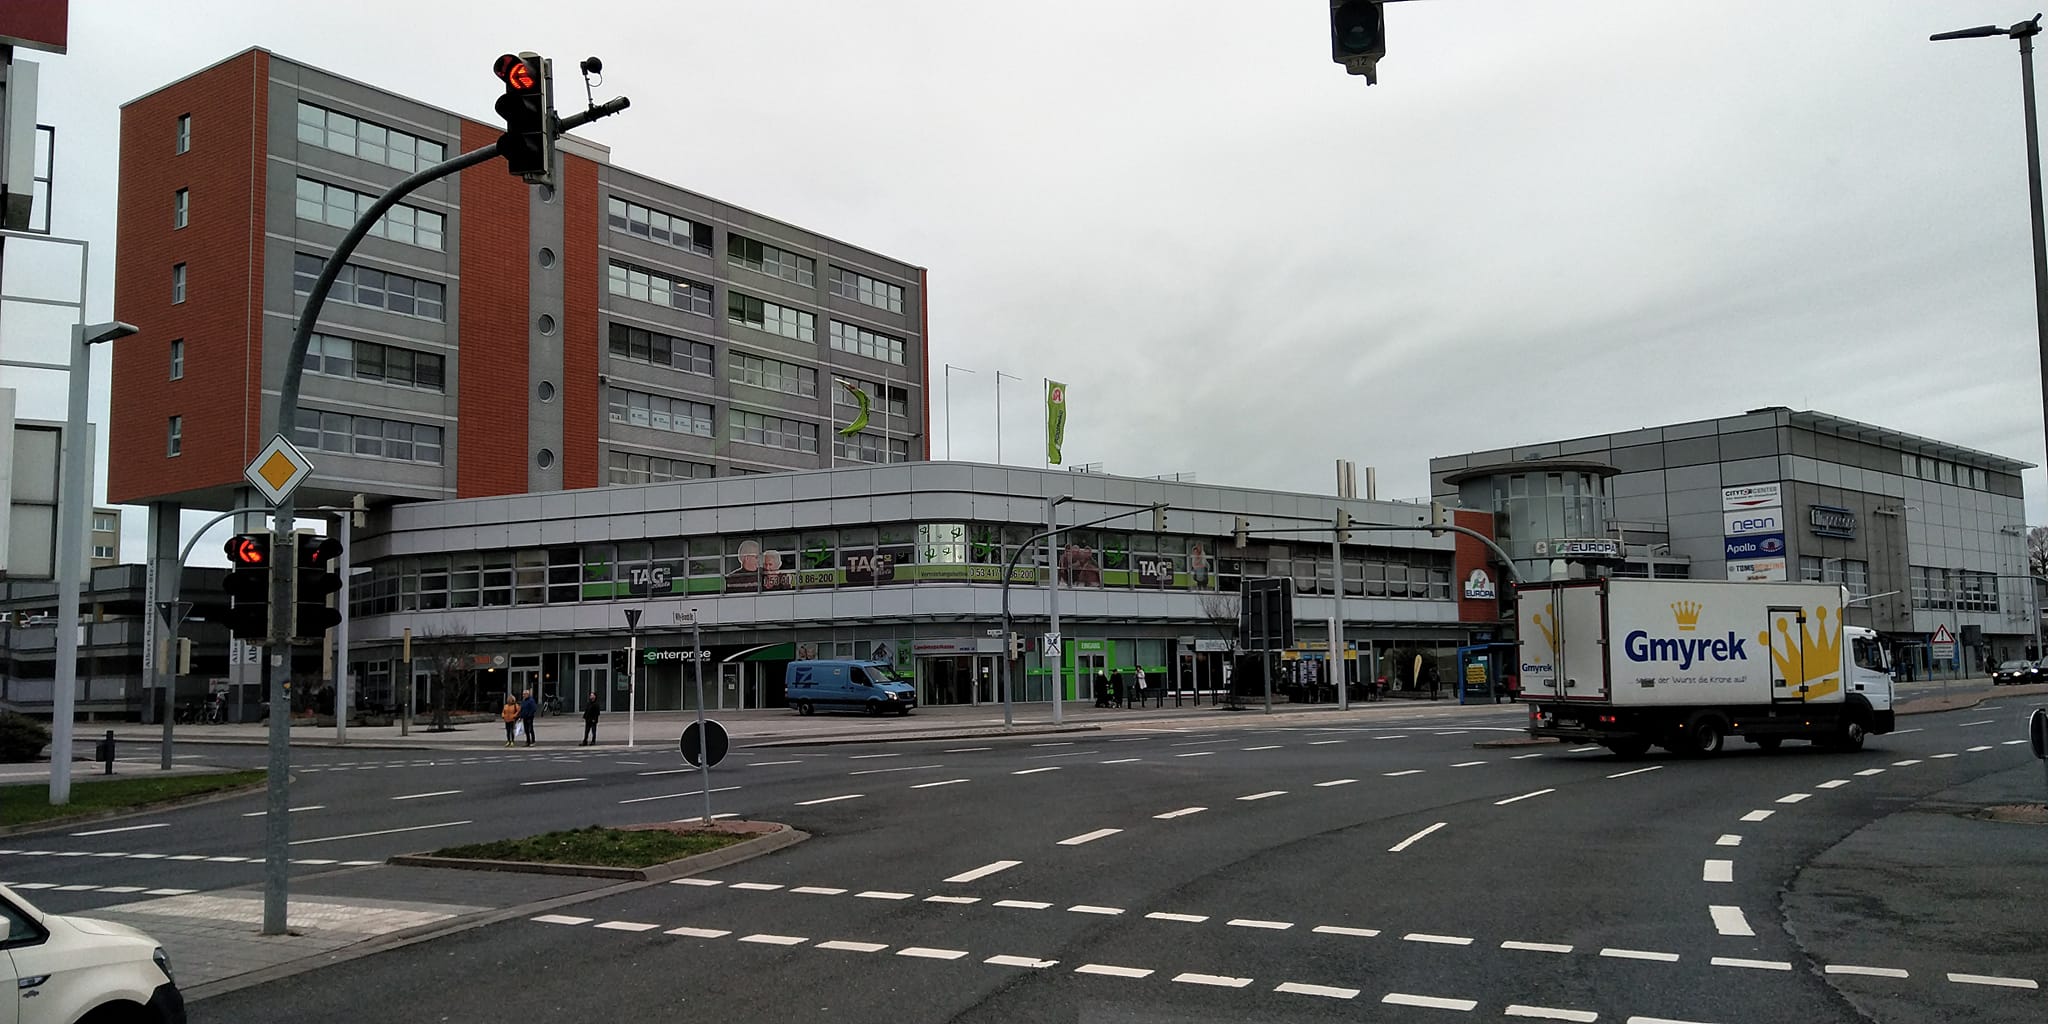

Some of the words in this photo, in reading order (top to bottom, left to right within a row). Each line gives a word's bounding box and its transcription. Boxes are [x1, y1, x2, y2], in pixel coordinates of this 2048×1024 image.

[1732, 517, 1775, 532] neon
[1571, 543, 1617, 552] EUROPA
[1726, 543, 1757, 554] Apollo
[848, 554, 884, 573] TAG
[1139, 560, 1167, 577] TAG
[631, 567, 664, 585] TAG
[805, 573, 834, 584] 86-200
[976, 568, 985, 577] 53
[1465, 589, 1495, 598] EUROPA
[647, 650, 711, 663] enterprise
[1625, 630, 1748, 671] Gmyrek
[1521, 663, 1553, 674] Gmyrek
